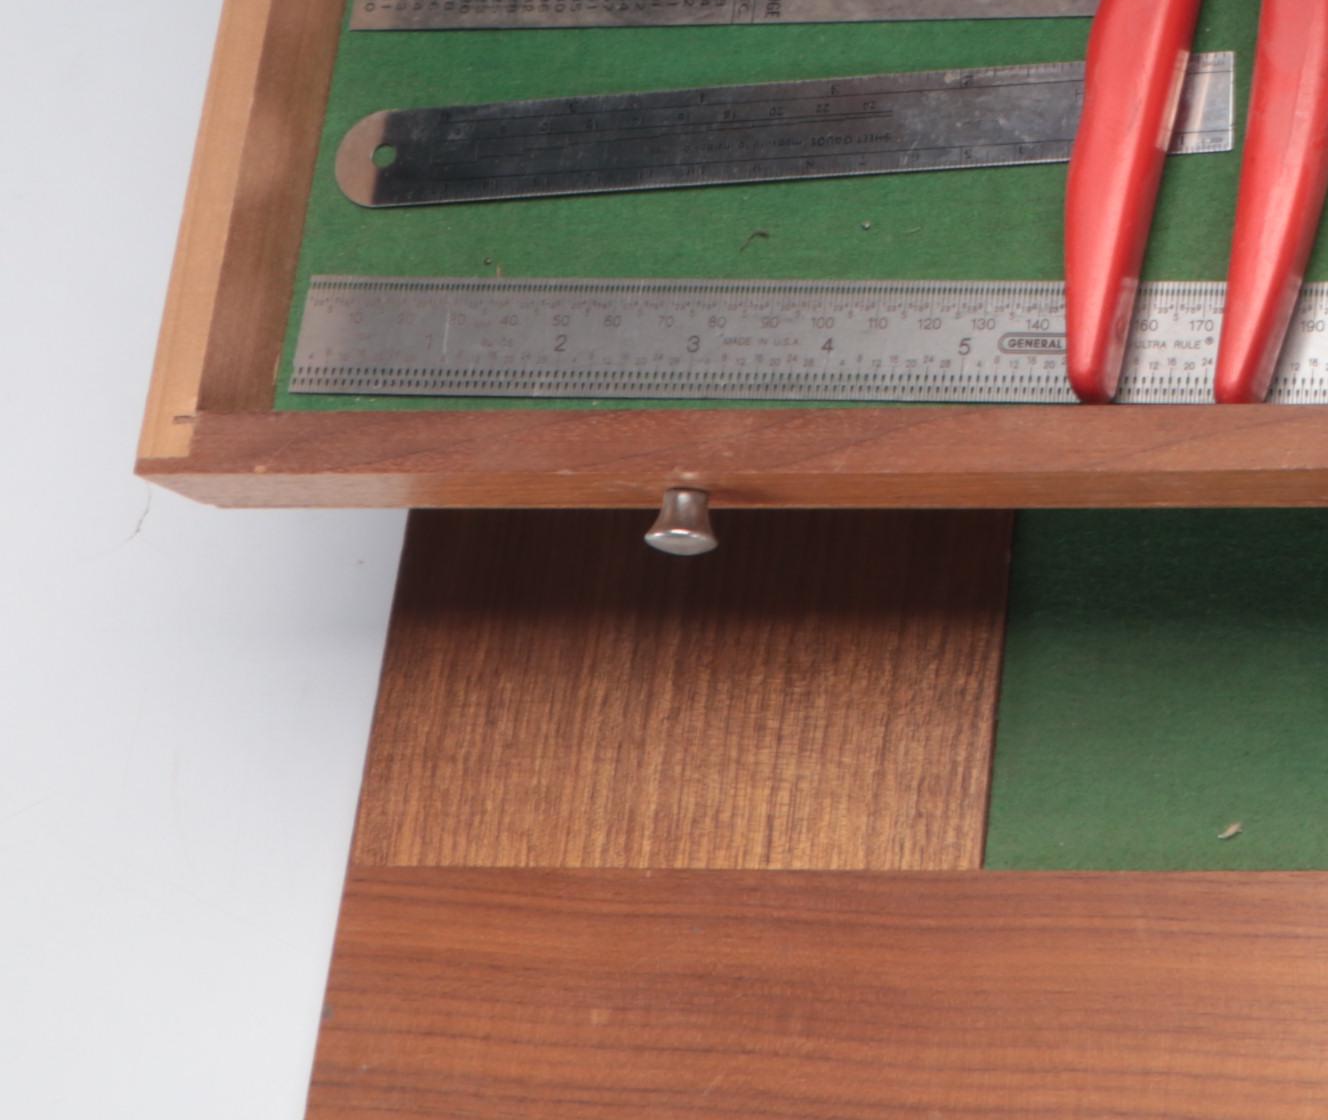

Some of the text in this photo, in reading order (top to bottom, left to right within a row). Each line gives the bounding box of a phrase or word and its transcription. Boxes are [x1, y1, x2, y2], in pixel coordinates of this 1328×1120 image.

[500, 314, 518, 326] 40
[552, 314, 570, 327] 50
[603, 316, 622, 328] 60
[657, 316, 675, 328] 70
[708, 316, 727, 329] 80
[760, 316, 780, 329] 90
[812, 316, 835, 330] 100
[868, 317, 888, 330] 110
[918, 318, 942, 330] 120
[971, 318, 996, 330] 130
[1026, 318, 1050, 331] 140
[1190, 320, 1214, 333] 170
[1302, 320, 1326, 333] 190
[553, 334, 568, 352] 2
[686, 335, 702, 354] 3
[722, 336, 752, 346] MADE
[758, 336, 768, 346] IN
[820, 336, 972, 356] 4 5
[1006, 338, 1062, 350] GENERAL
